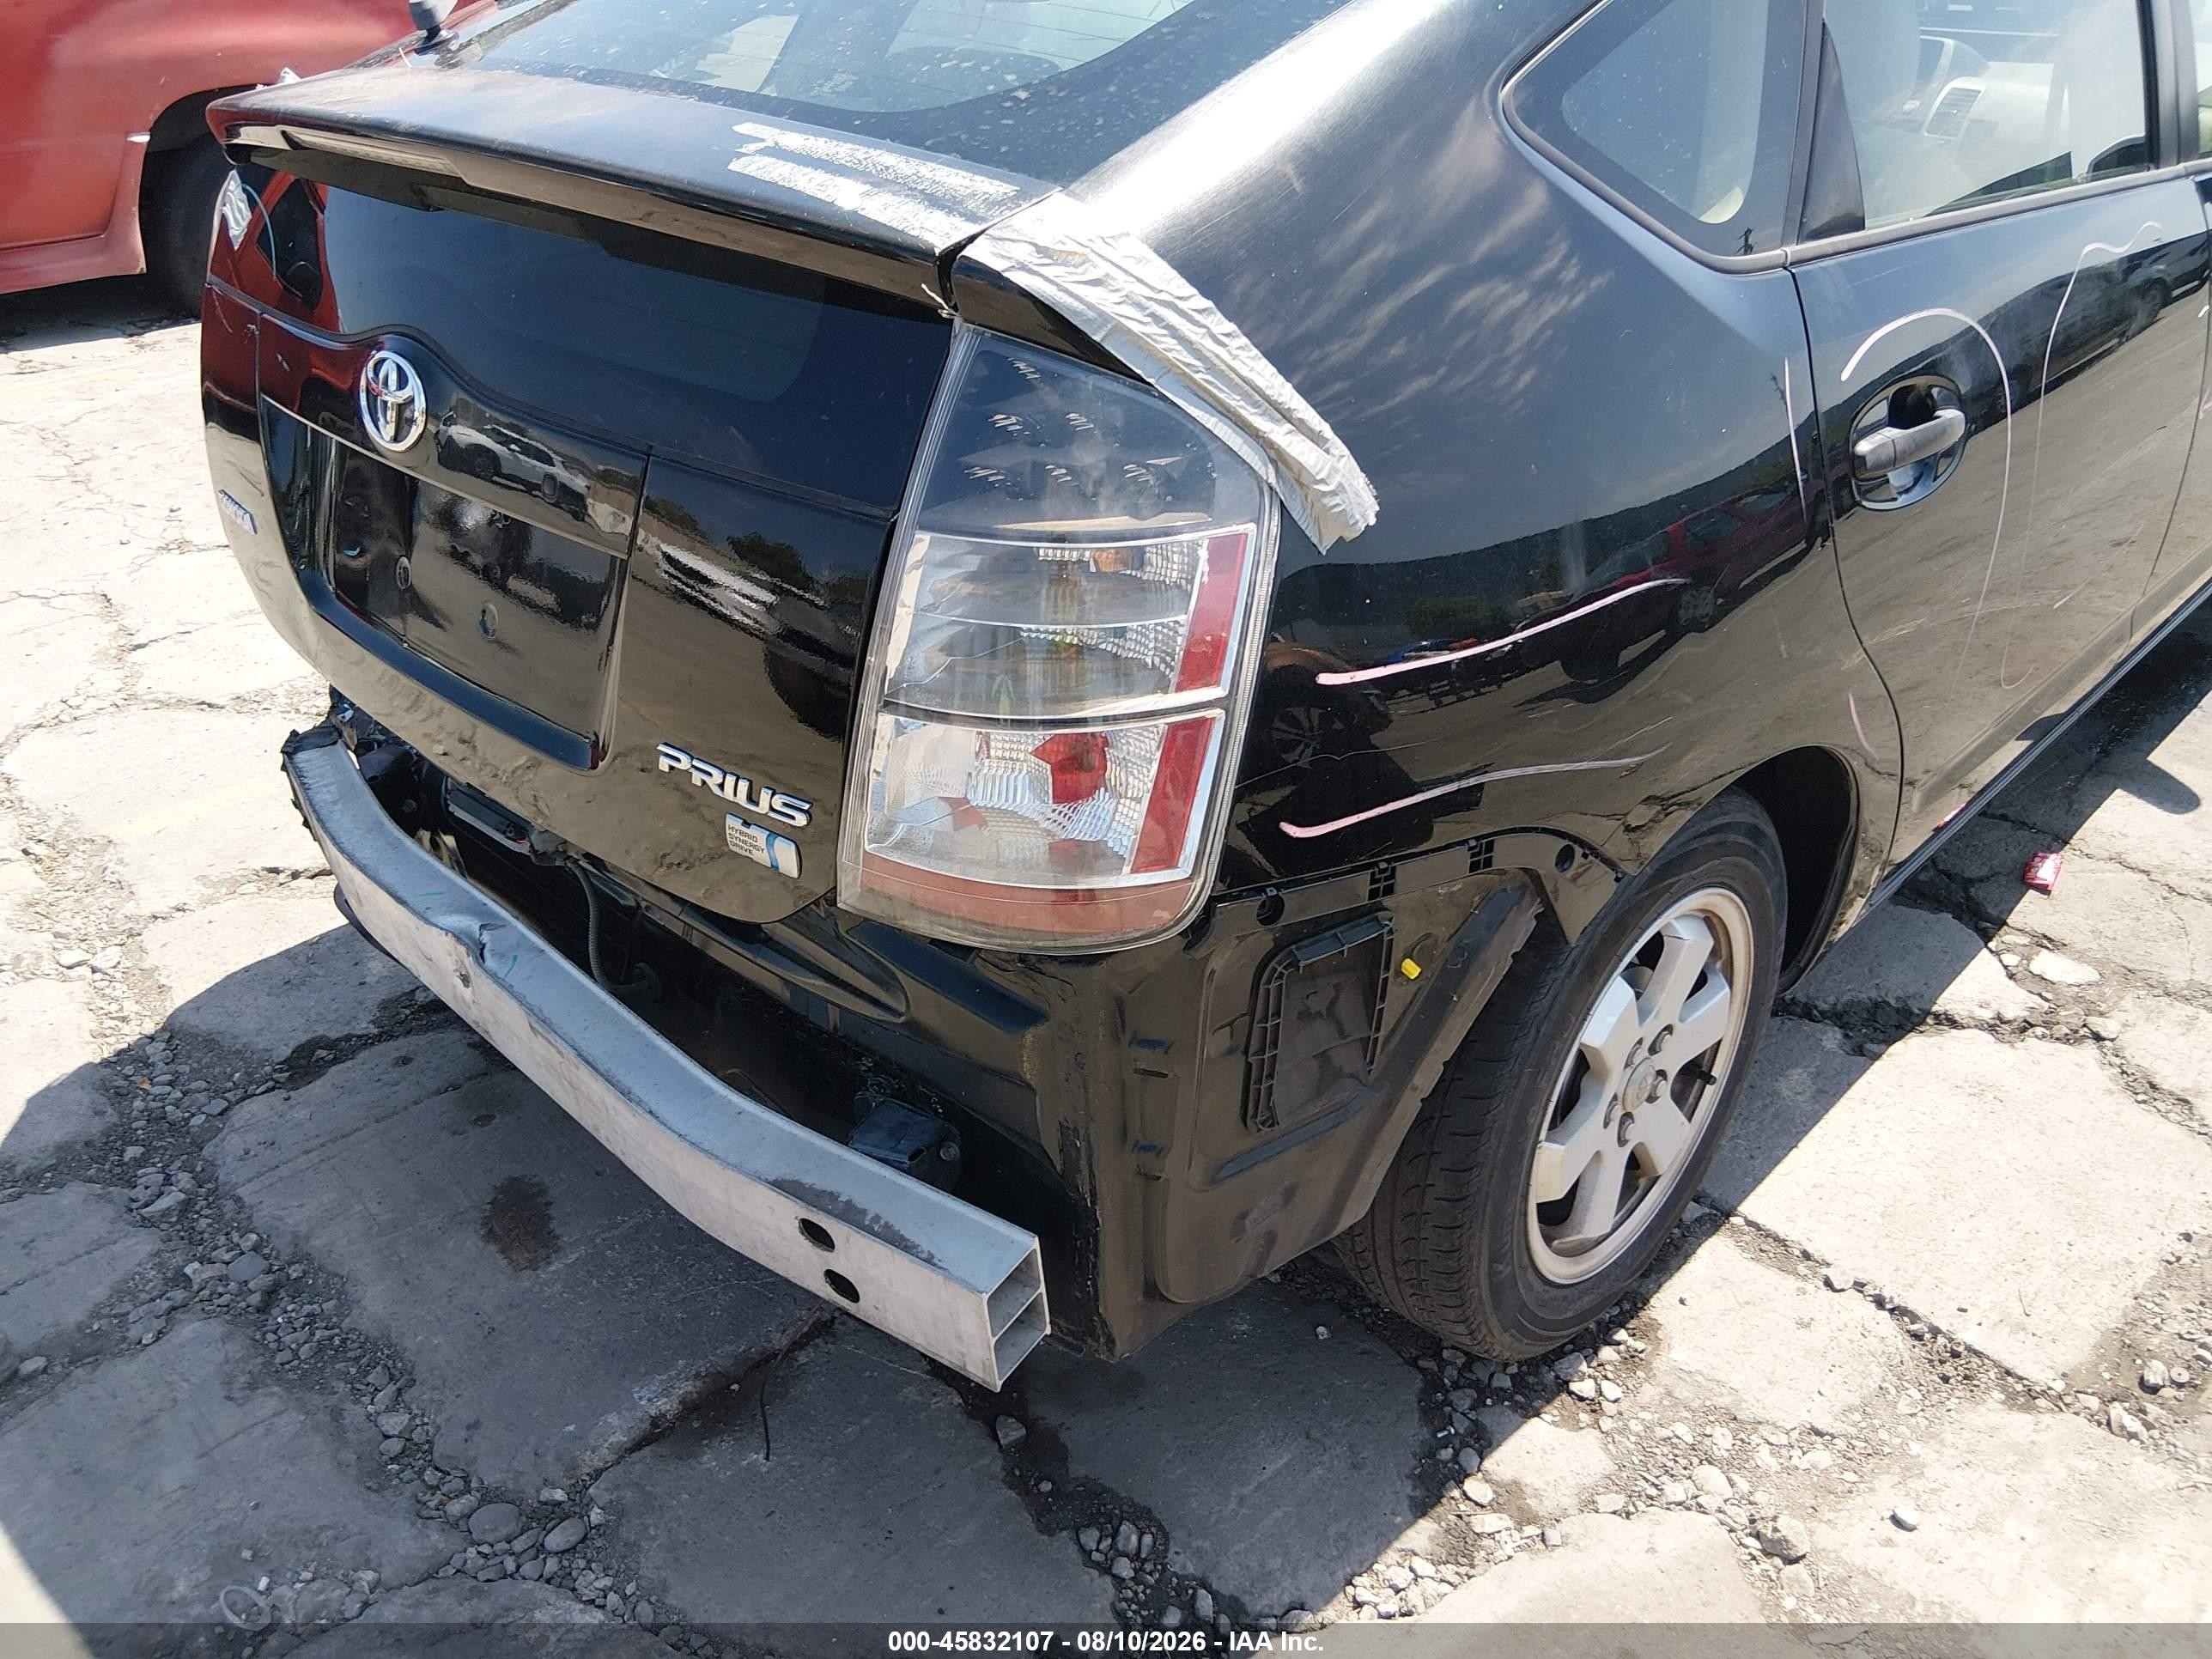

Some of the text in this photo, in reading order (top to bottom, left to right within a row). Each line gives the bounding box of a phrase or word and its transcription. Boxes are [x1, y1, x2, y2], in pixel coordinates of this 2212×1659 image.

[656, 742, 813, 827] PRIUS
[728, 824, 758, 842] HYBRID
[728, 832, 765, 854] SYNERGY
[730, 840, 755, 856] DRIVE
